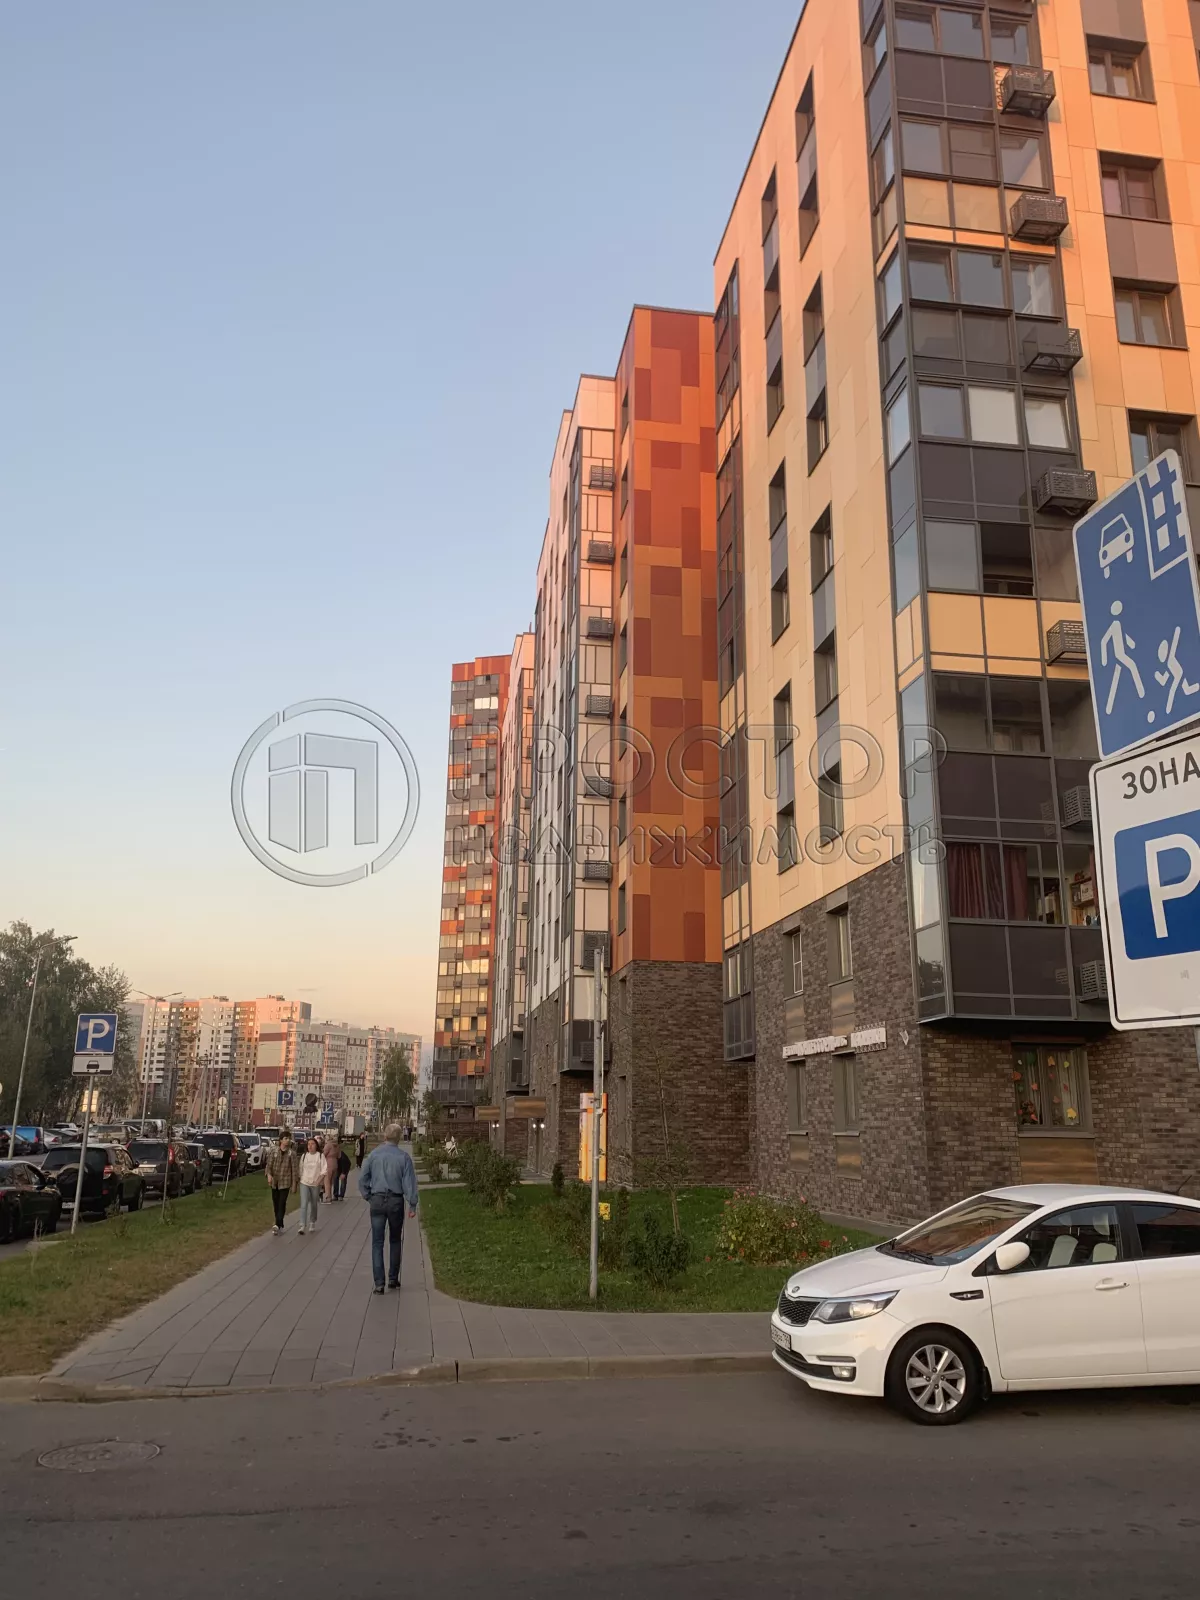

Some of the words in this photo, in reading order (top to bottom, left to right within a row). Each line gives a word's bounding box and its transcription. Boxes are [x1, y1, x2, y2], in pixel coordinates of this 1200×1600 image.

[1121, 751, 1200, 800] ЗОНА
[1144, 832, 1200, 939] P
[86, 1018, 110, 1049] P
[281, 1091, 292, 1105] P
